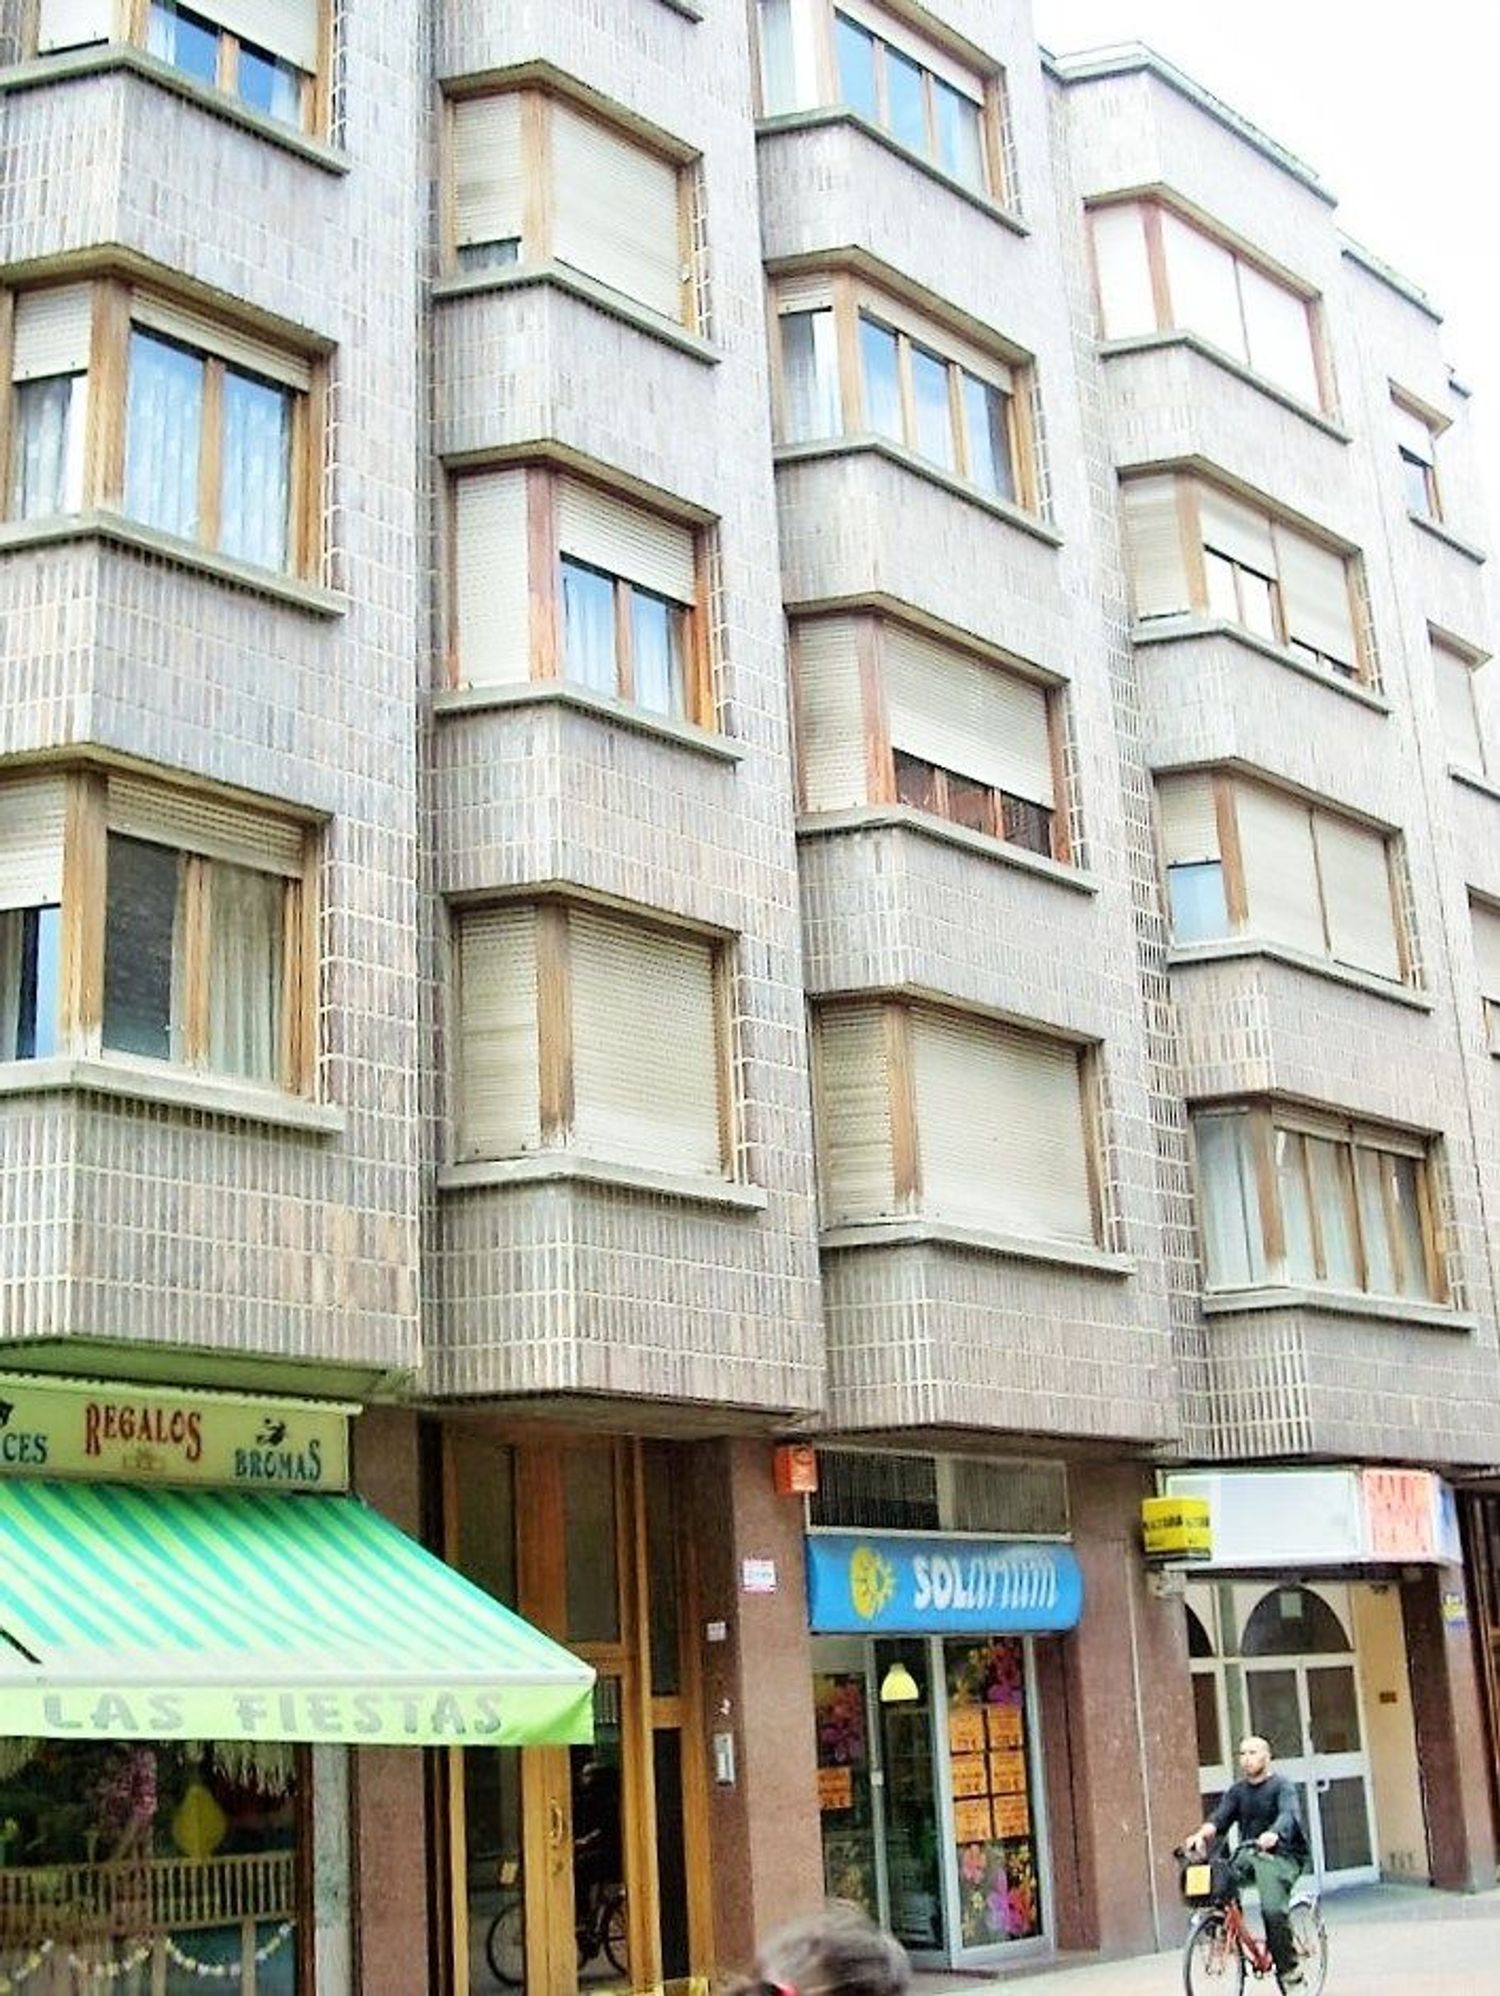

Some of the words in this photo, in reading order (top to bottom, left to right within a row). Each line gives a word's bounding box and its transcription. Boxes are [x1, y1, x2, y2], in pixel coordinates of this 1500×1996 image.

[86, 1403, 202, 1461] REGALOS
[234, 1439, 322, 1482] BROMAS
[42, 1692, 184, 1731] LAS
[231, 1692, 503, 1735] FIESTAS
